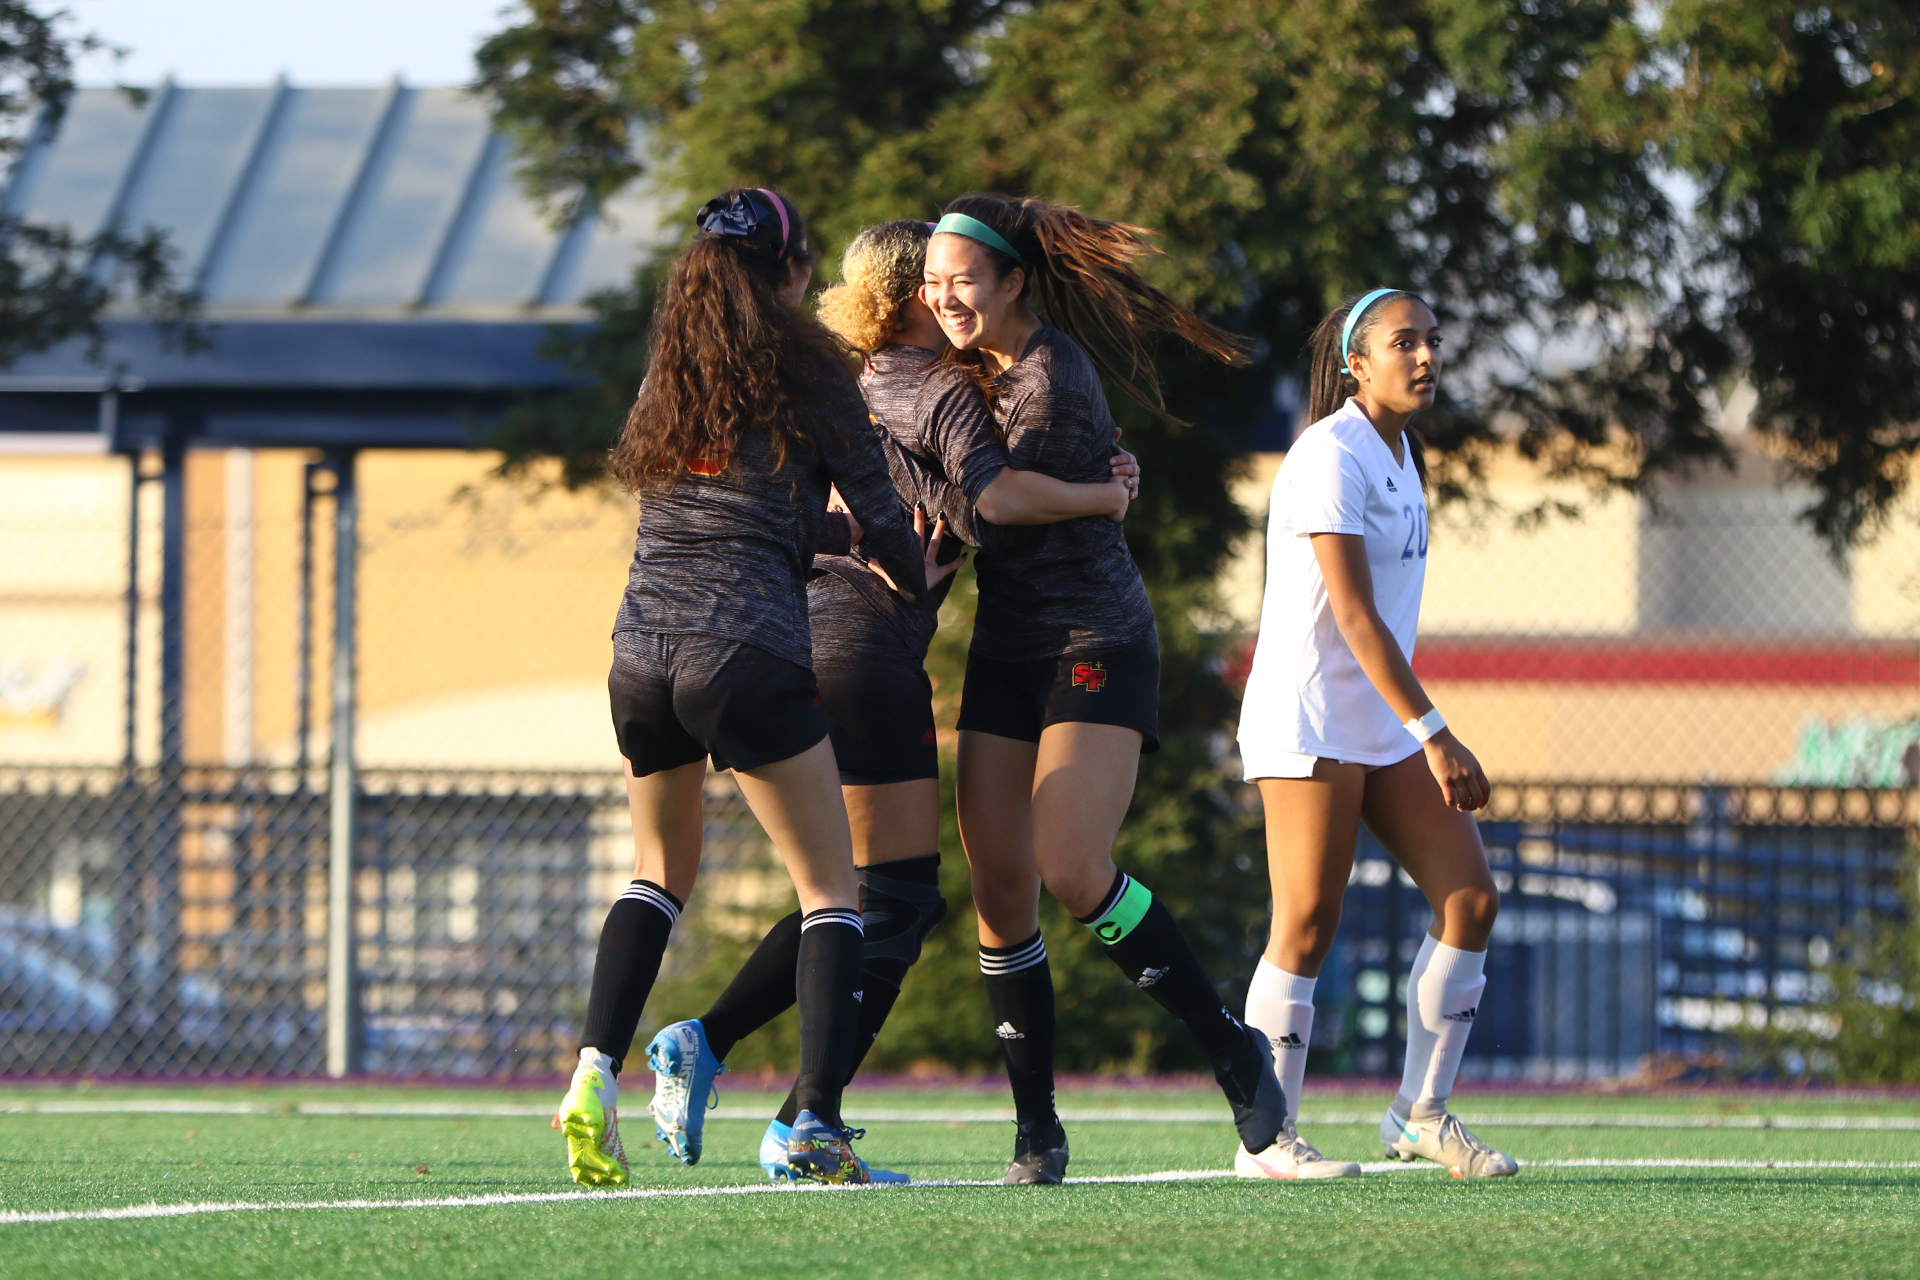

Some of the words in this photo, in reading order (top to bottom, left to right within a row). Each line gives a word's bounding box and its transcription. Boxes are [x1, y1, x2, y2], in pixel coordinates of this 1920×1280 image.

[1401, 503, 1429, 560] 20
[1095, 921, 1122, 942] C
[1271, 1041, 1306, 1050] didas
